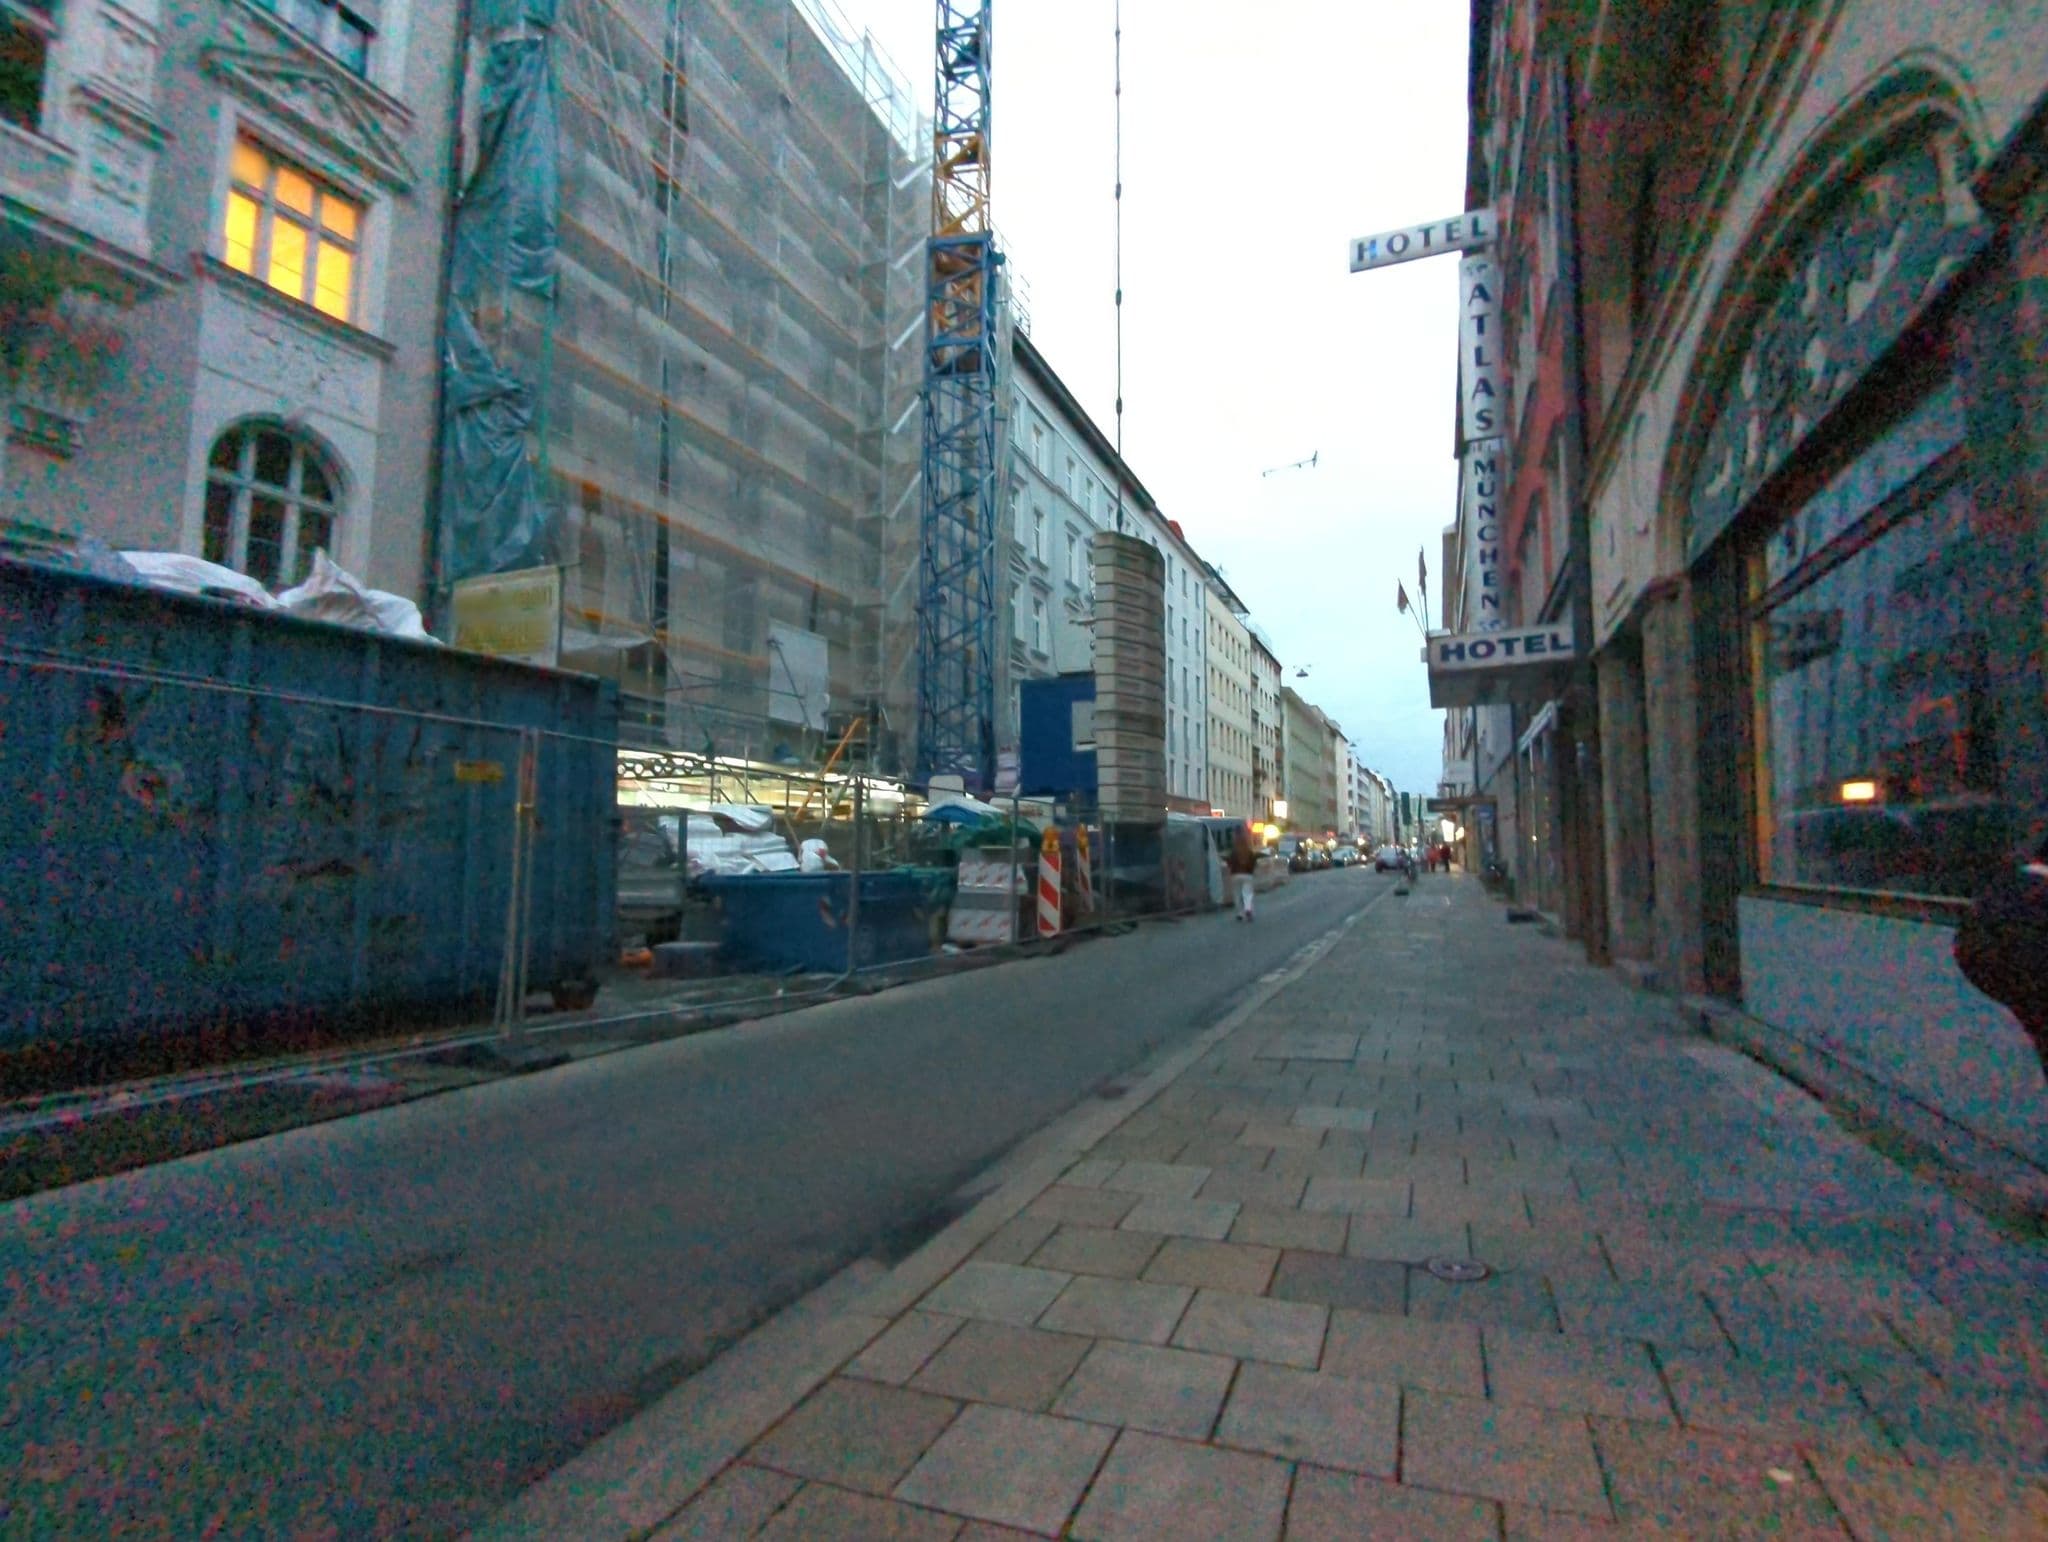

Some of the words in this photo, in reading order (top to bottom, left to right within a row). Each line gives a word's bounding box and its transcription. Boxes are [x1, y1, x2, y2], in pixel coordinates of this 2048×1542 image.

[1356, 216, 1488, 262] HOTEL
[1468, 283, 1496, 431] ATLAS
[1439, 632, 1573, 663] HOTEL
